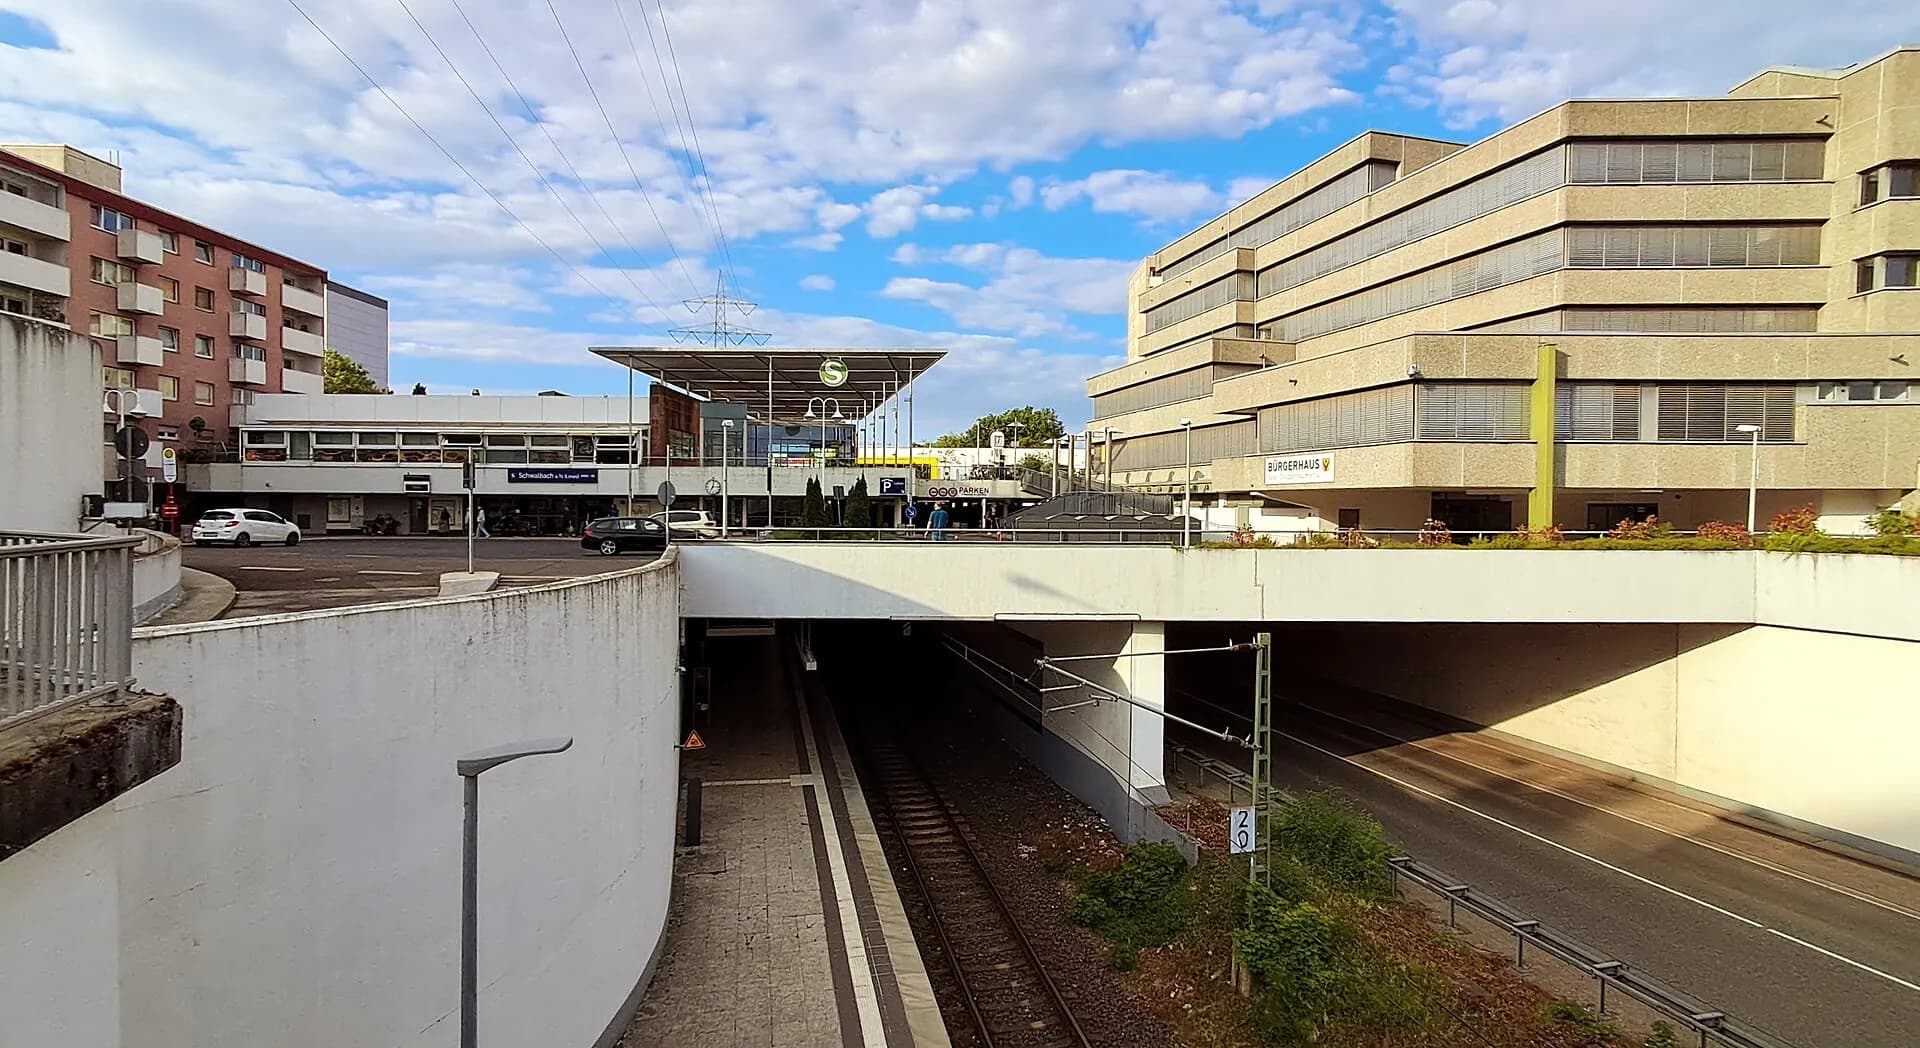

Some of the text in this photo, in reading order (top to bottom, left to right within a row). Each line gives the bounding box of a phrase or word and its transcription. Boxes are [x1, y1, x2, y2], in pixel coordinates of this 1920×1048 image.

[824, 361, 843, 384] S
[1268, 458, 1320, 472] BÜRGERHAUS
[883, 481, 891, 492] P
[1238, 810, 1249, 828] 2
[1238, 830, 1249, 849] 0
